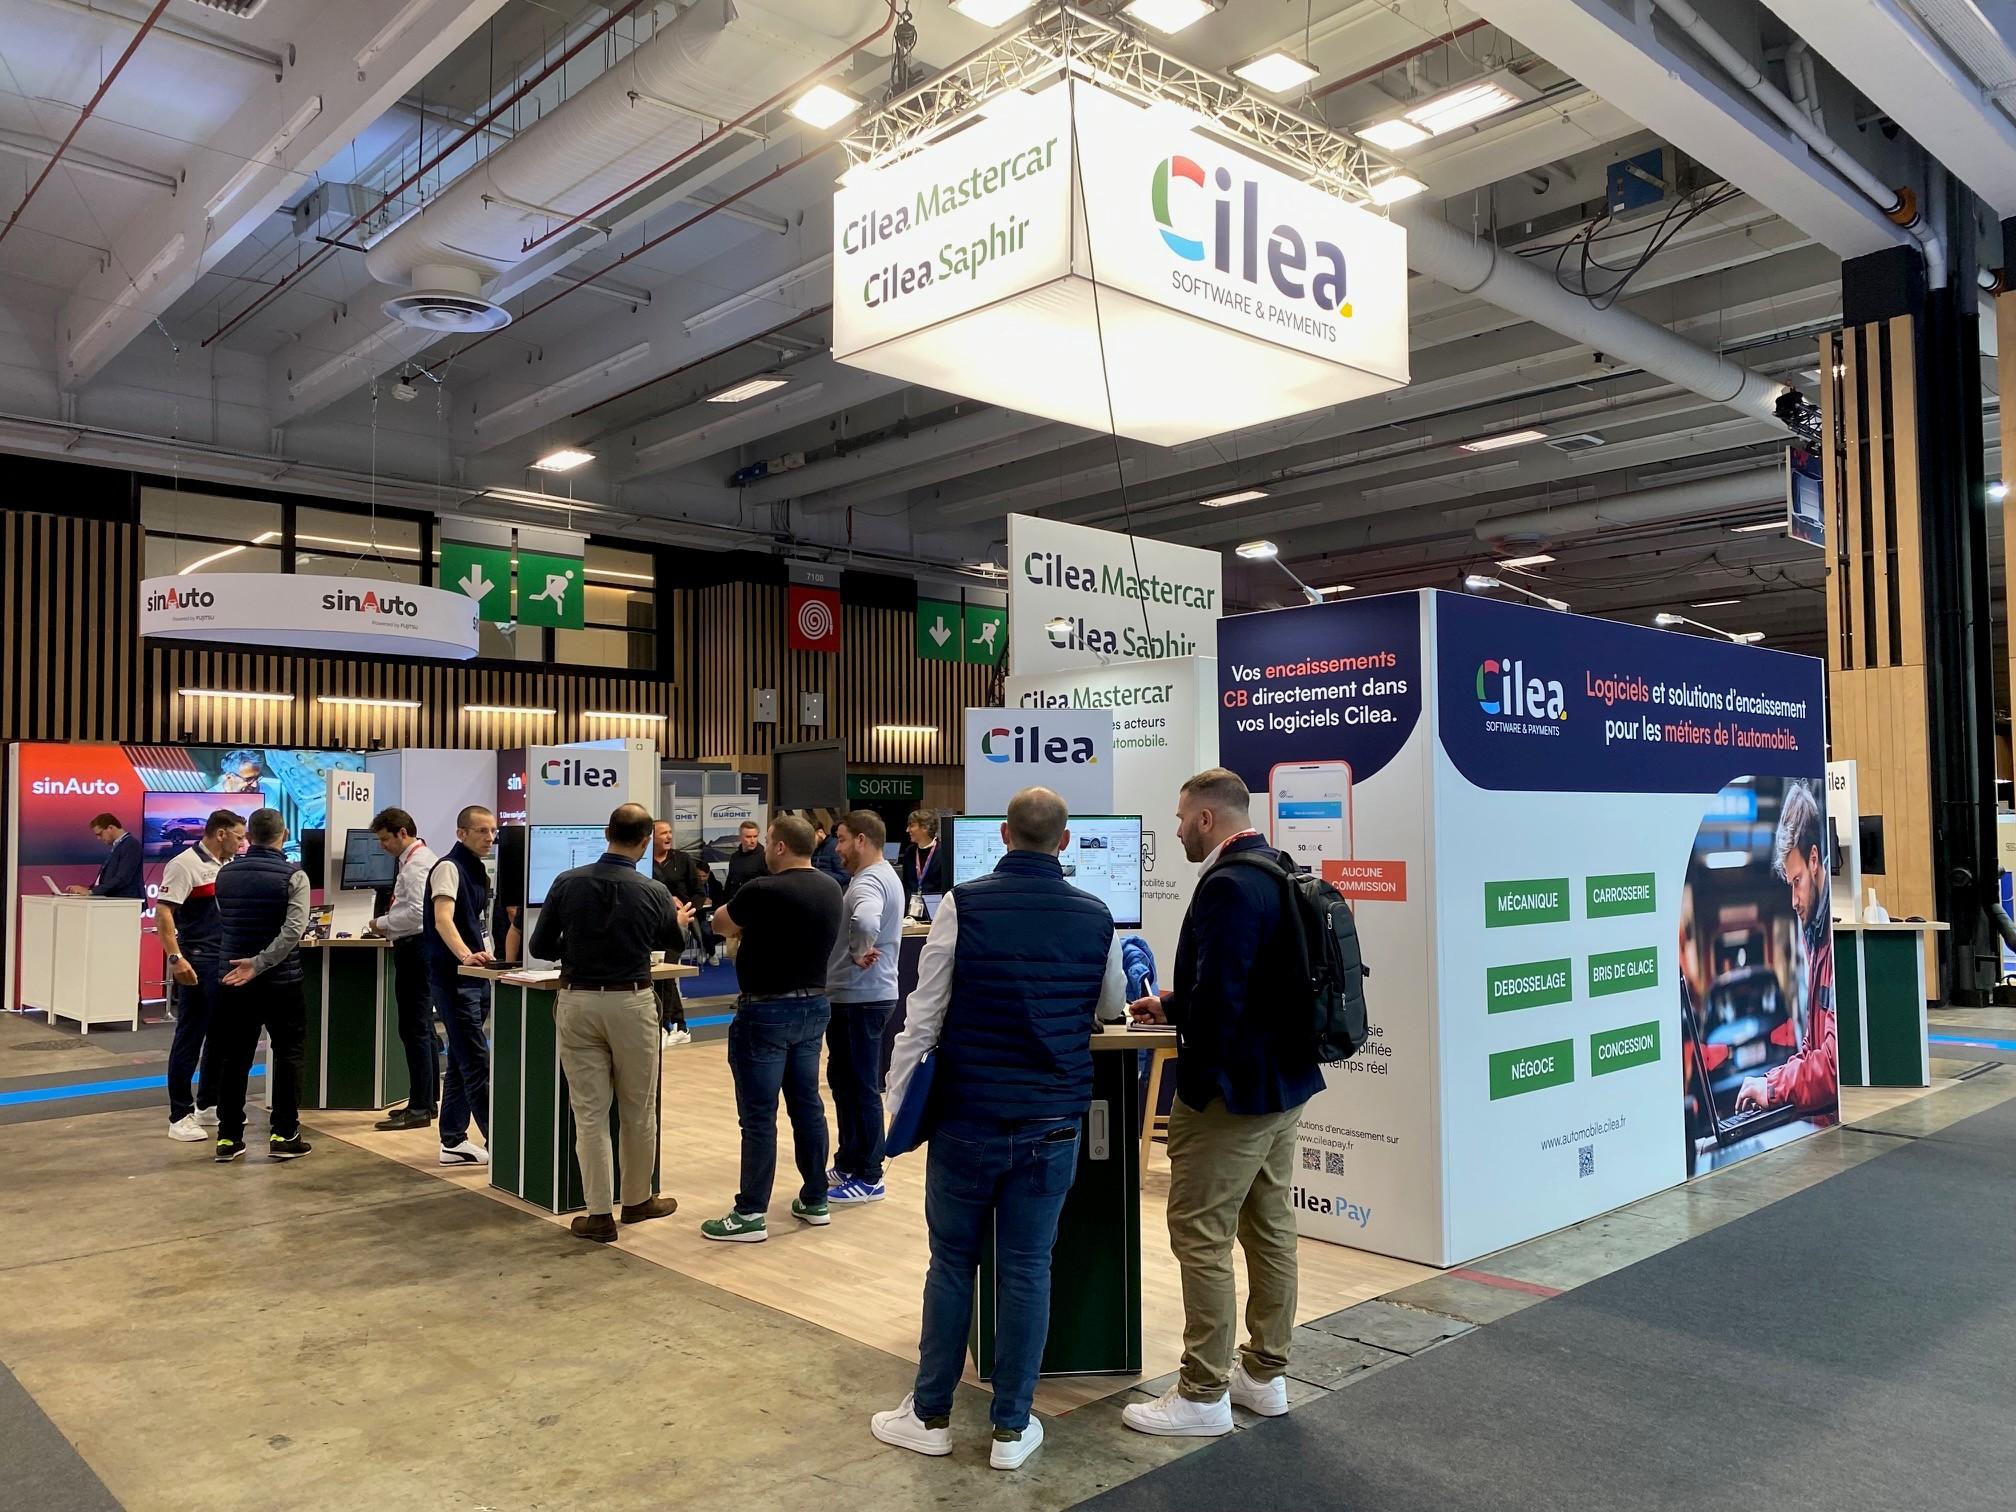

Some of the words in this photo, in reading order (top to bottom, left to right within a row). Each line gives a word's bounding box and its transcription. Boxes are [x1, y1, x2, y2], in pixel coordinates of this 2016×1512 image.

[915, 137, 1058, 226] Mastercar
[938, 214, 1030, 280] Saphir
[1172, 270, 1251, 315] SOFTWARE
[1255, 300, 1265, 320] &
[1268, 304, 1337, 343] PAYMENTS
[1101, 564, 1215, 609] Mastercar
[147, 587, 215, 612] sinAuto
[322, 589, 418, 617] sinAuto
[1231, 664, 1261, 682] Vos
[1265, 651, 1396, 679] encaissements
[1073, 684, 1173, 709] Mastercar
[1224, 690, 1248, 708] CB
[1252, 680, 1358, 706] directement
[1362, 677, 1408, 697] dans
[1586, 670, 1649, 706] Logiciels
[1652, 682, 1665, 704] et
[1668, 682, 1723, 710] solutions
[1725, 688, 1807, 719] d'encaissement
[1124, 716, 1166, 730] acteurs
[1236, 718, 1265, 732] vos
[1269, 708, 1340, 734] logiciels
[1344, 705, 1398, 725] Cilea.
[1485, 720, 1522, 734] SOFTWARE
[1522, 724, 1528, 734] &
[1528, 724, 1560, 736] PAYMENTS
[1605, 719, 1639, 746] pour
[1643, 715, 1662, 741] les
[1665, 719, 1712, 745] métiers
[1714, 722, 1729, 746] de
[1731, 723, 1799, 751] l'automobile.
[32, 777, 120, 795] sinAuto
[860, 779, 912, 795] SORTIE
[1828, 771, 1846, 791] ilea
[1166, 880, 1177, 888] sur
[1341, 867, 1383, 878] AUCUNE
[1143, 891, 1181, 902] martphone.
[1331, 880, 1396, 892] COMMISSION
[1593, 884, 1650, 903] CARROSSERIE
[1498, 891, 1559, 912] MÉCANIQUE
[1593, 966, 1612, 982] BRIS
[1614, 963, 1626, 979] DE
[1627, 959, 1654, 977] GLACE
[1494, 972, 1566, 998] DEBOSSELAGE
[1367, 1024, 1384, 1037] sie
[1358, 1041, 1392, 1057] plifiée
[1598, 1034, 1654, 1060] CONCESSION
[1366, 1061, 1388, 1075] réel
[1512, 1056, 1555, 1081] NÉGOCE
[1295, 1119, 1324, 1132] olutions
[1325, 1125, 1385, 1142] d'encaissement
[1386, 1135, 1400, 1144] sur
[1541, 1114, 1627, 1151] www.automobile.cilea.fr
[1335, 1196, 1371, 1228] Pay
